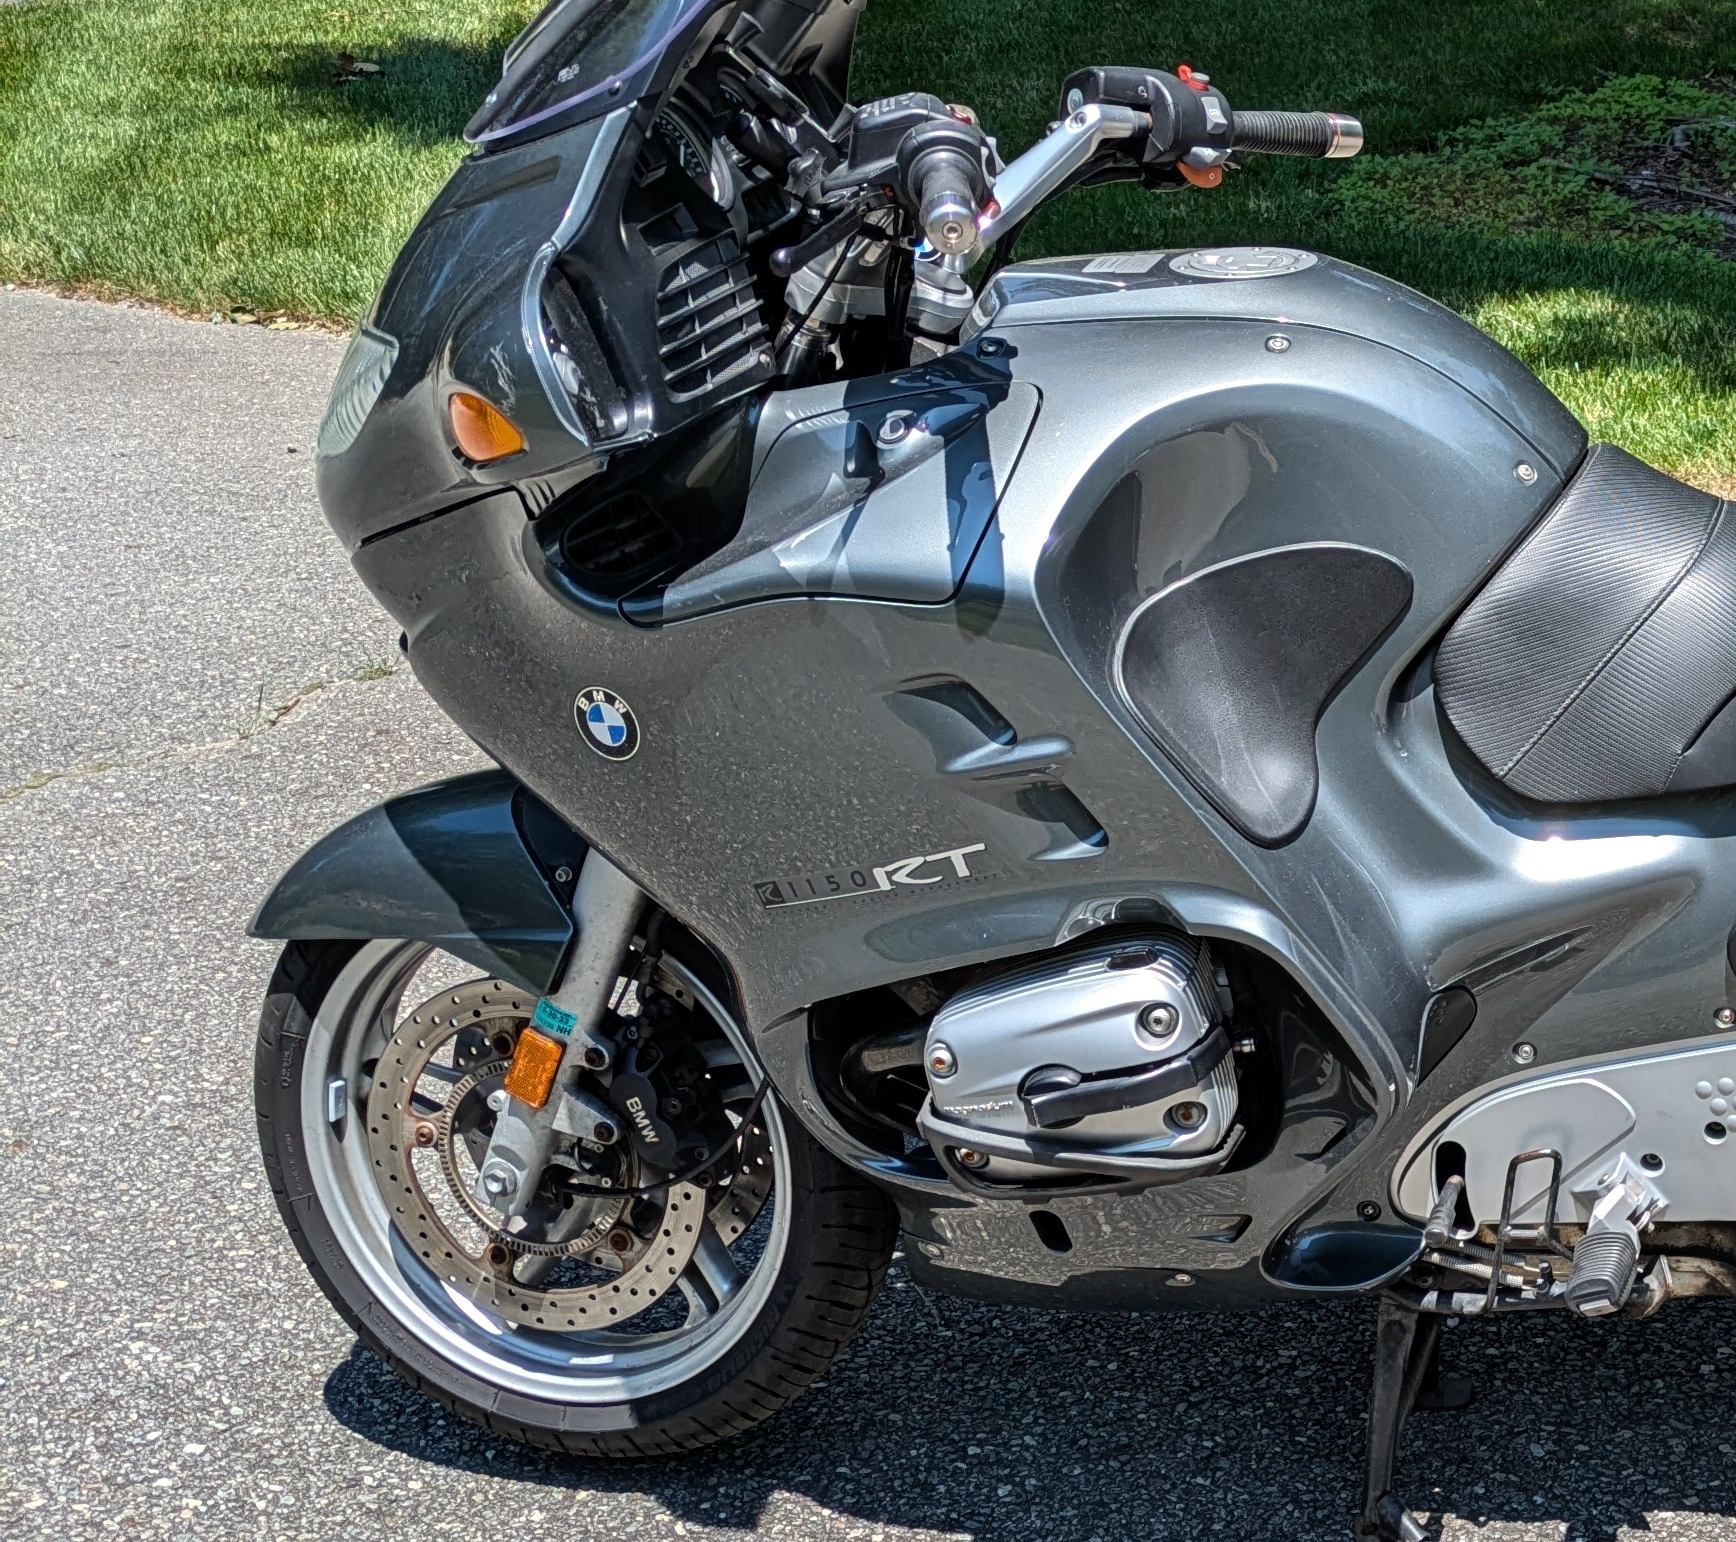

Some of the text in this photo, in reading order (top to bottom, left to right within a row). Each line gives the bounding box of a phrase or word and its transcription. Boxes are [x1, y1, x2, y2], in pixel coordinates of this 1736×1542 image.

[577, 690, 628, 714] BMW
[555, 1024, 573, 1036] NH
[625, 1096, 660, 1143] BMW
